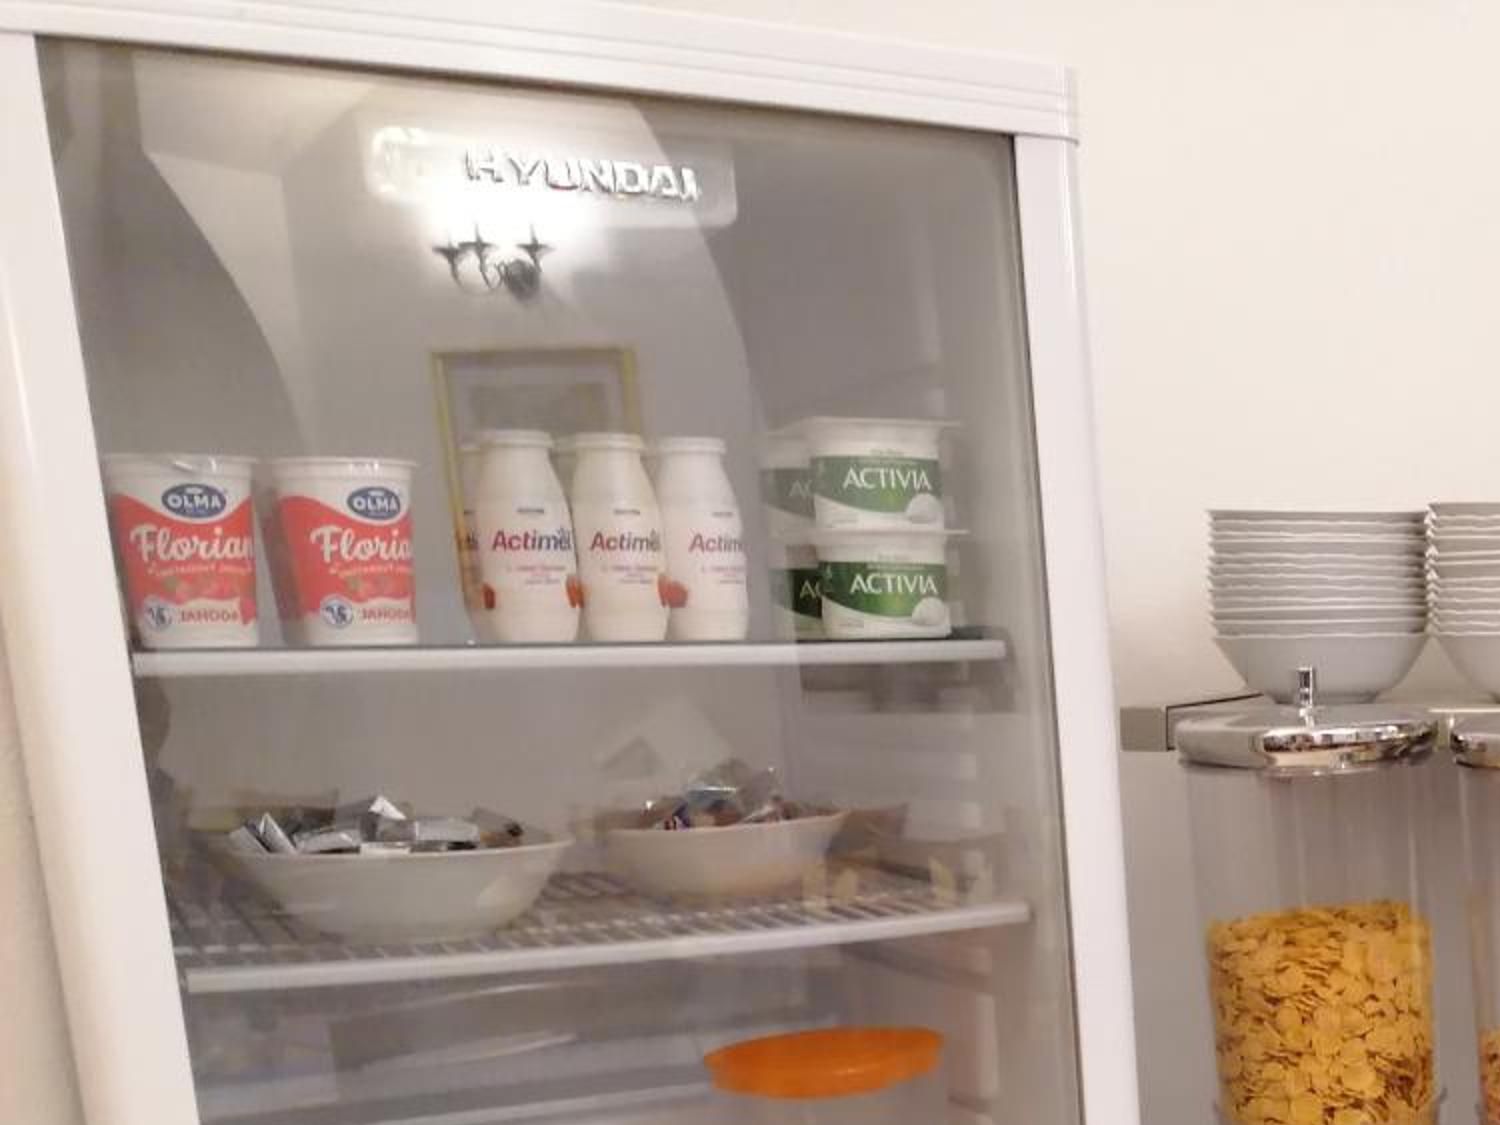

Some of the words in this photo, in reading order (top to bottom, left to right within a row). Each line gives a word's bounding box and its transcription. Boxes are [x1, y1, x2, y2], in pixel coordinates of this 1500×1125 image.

[465, 146, 699, 202] HYUNDAI
[842, 467, 932, 489] ACTIVIA
[166, 493, 222, 510] OLMA
[352, 495, 399, 511] OLMA
[850, 573, 939, 595] ACTIVIA
